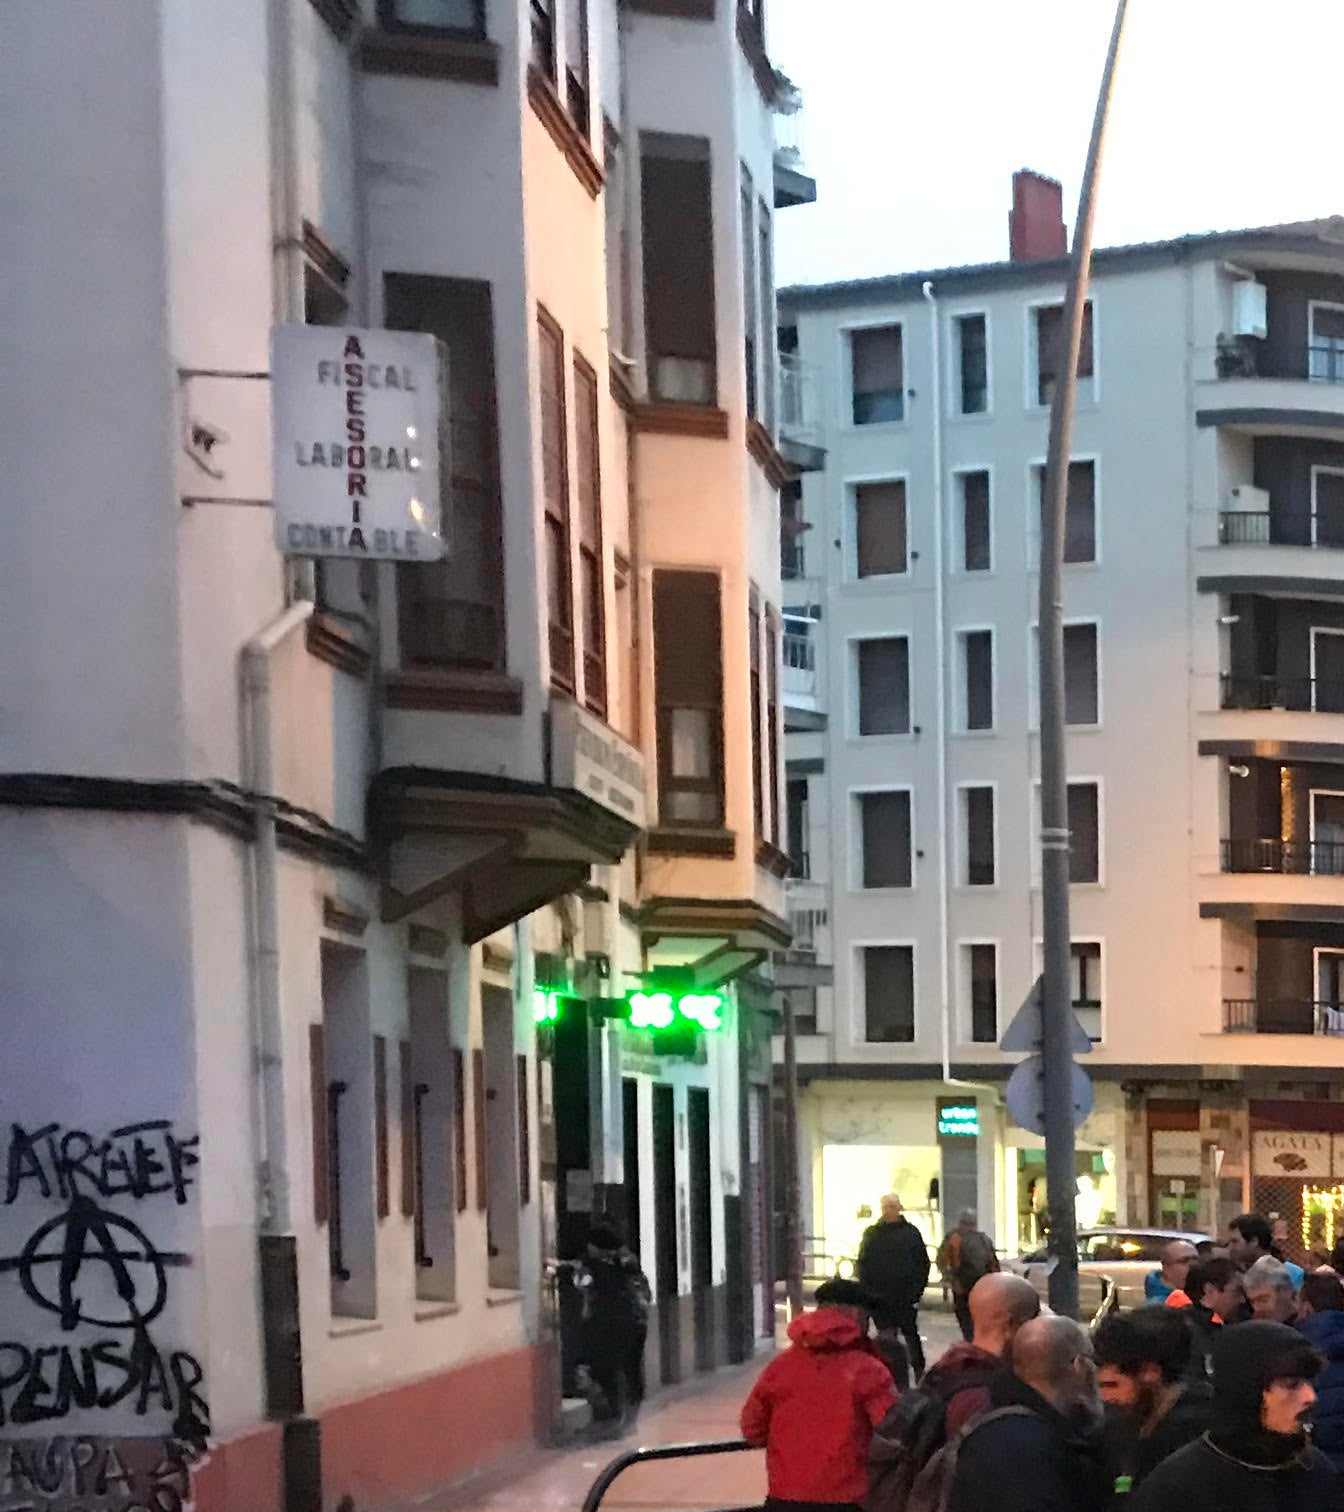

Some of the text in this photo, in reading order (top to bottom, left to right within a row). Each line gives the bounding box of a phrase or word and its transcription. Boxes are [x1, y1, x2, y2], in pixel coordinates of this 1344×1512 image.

[317, 359, 419, 392] FISCAL
[295, 441, 423, 474] LABORAL
[343, 334, 368, 552] ASESORIA
[286, 523, 420, 555] CONTABLE
[0, 1328, 212, 1442] PENSAR
